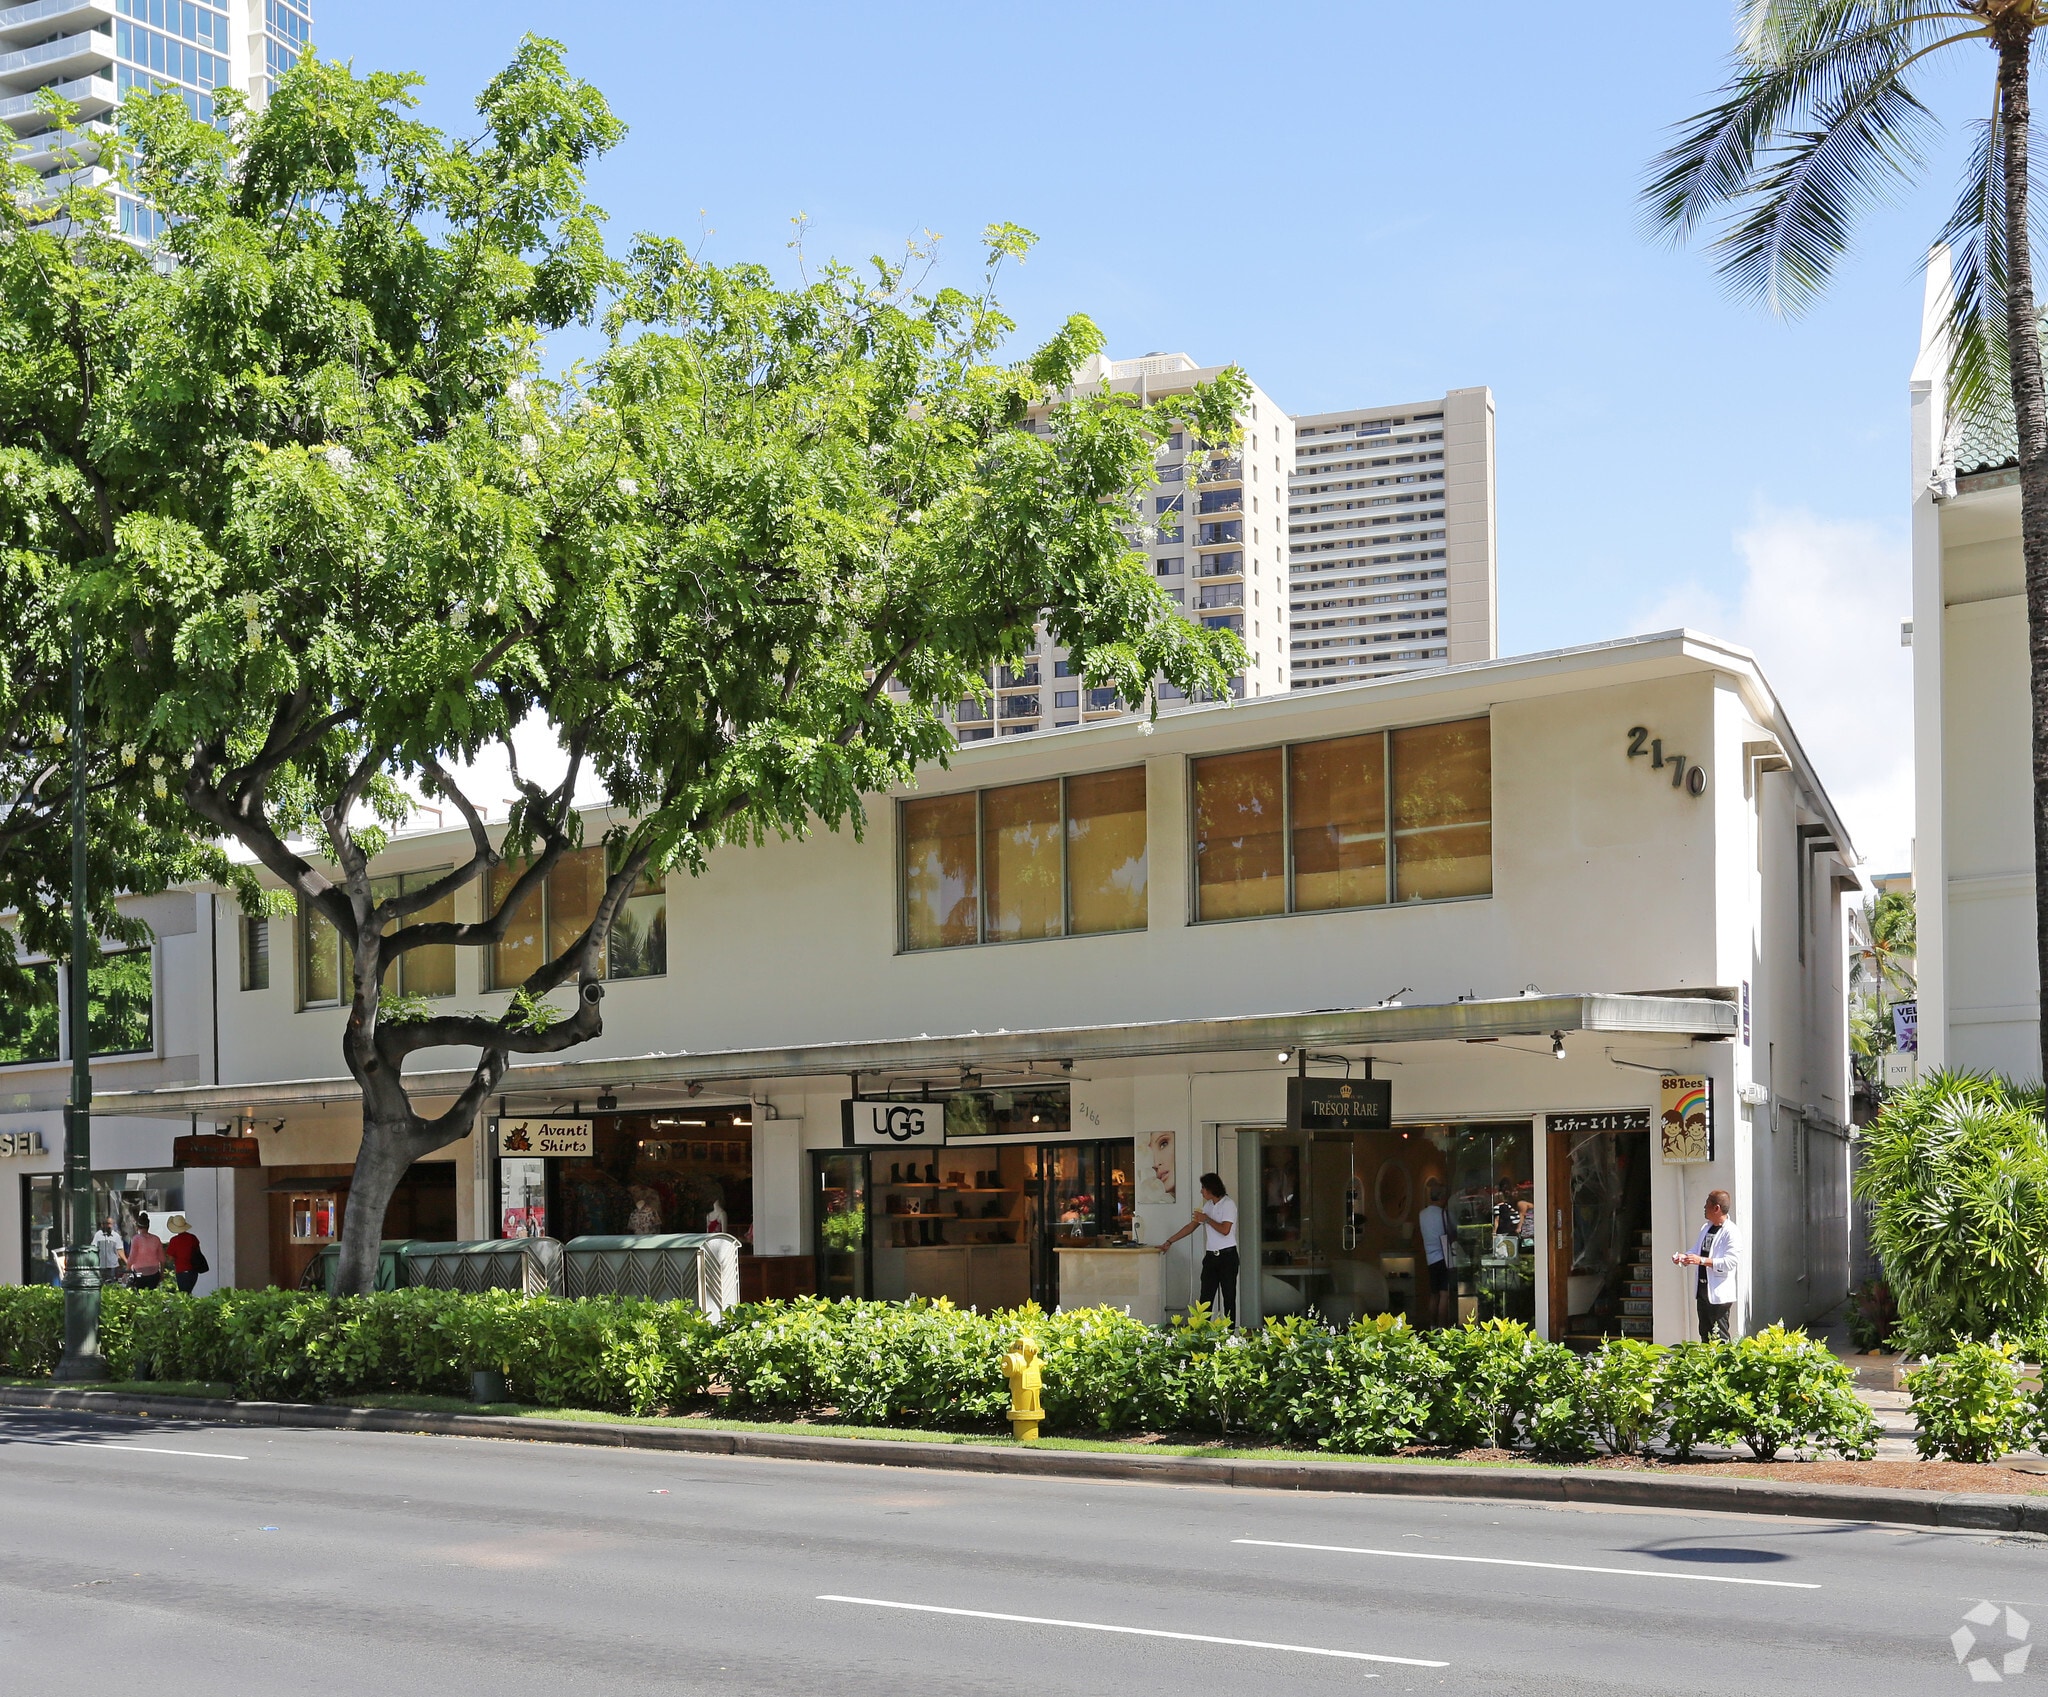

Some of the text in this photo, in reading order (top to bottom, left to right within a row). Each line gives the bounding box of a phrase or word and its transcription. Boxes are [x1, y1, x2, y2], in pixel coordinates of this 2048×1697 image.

[1627, 726, 1707, 797] 2170
[1080, 1102, 1099, 1126] 2166
[1311, 1100, 1378, 1116] TRÉSOR RARE
[538, 1124, 588, 1136] Avanti
[872, 1106, 925, 1141] UGG
[0, 1132, 47, 1158] SEL
[540, 1139, 586, 1152] Shirts
